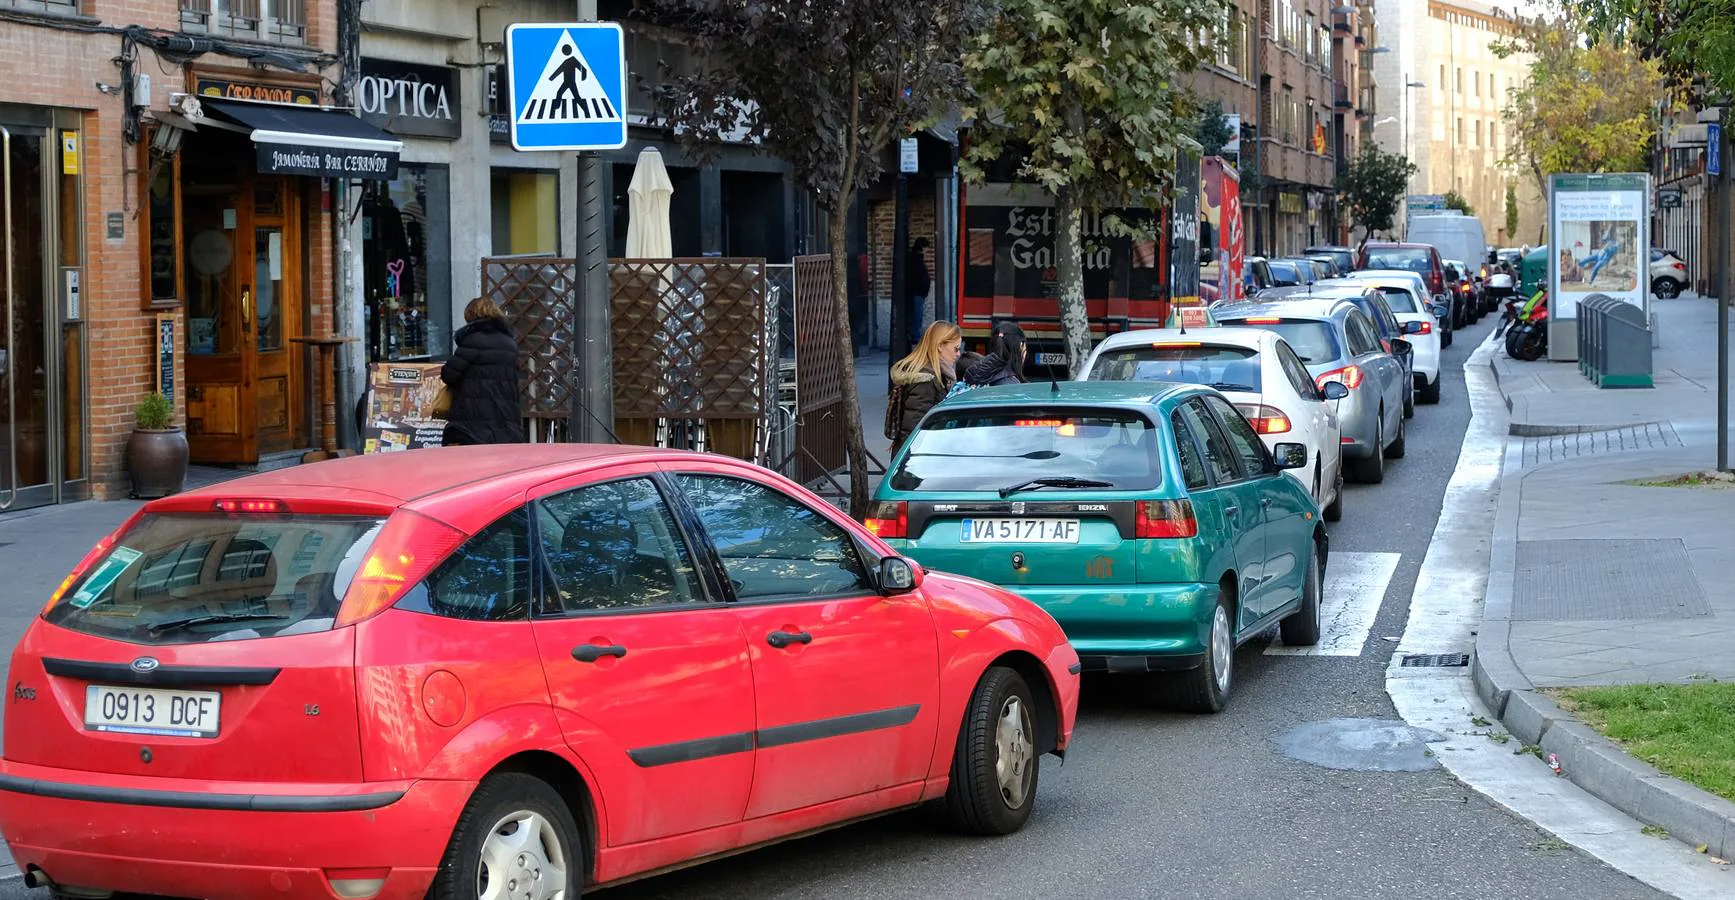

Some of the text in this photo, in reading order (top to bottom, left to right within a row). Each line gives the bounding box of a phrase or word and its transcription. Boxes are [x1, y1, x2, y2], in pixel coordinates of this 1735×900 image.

[360, 75, 453, 120] OPTICA
[344, 153, 388, 173] CERANDA
[1005, 206, 1120, 239] Estlla
[1010, 238, 1112, 272] Gaia
[973, 520, 995, 539] VA
[102, 691, 212, 726] 0913 DCF
